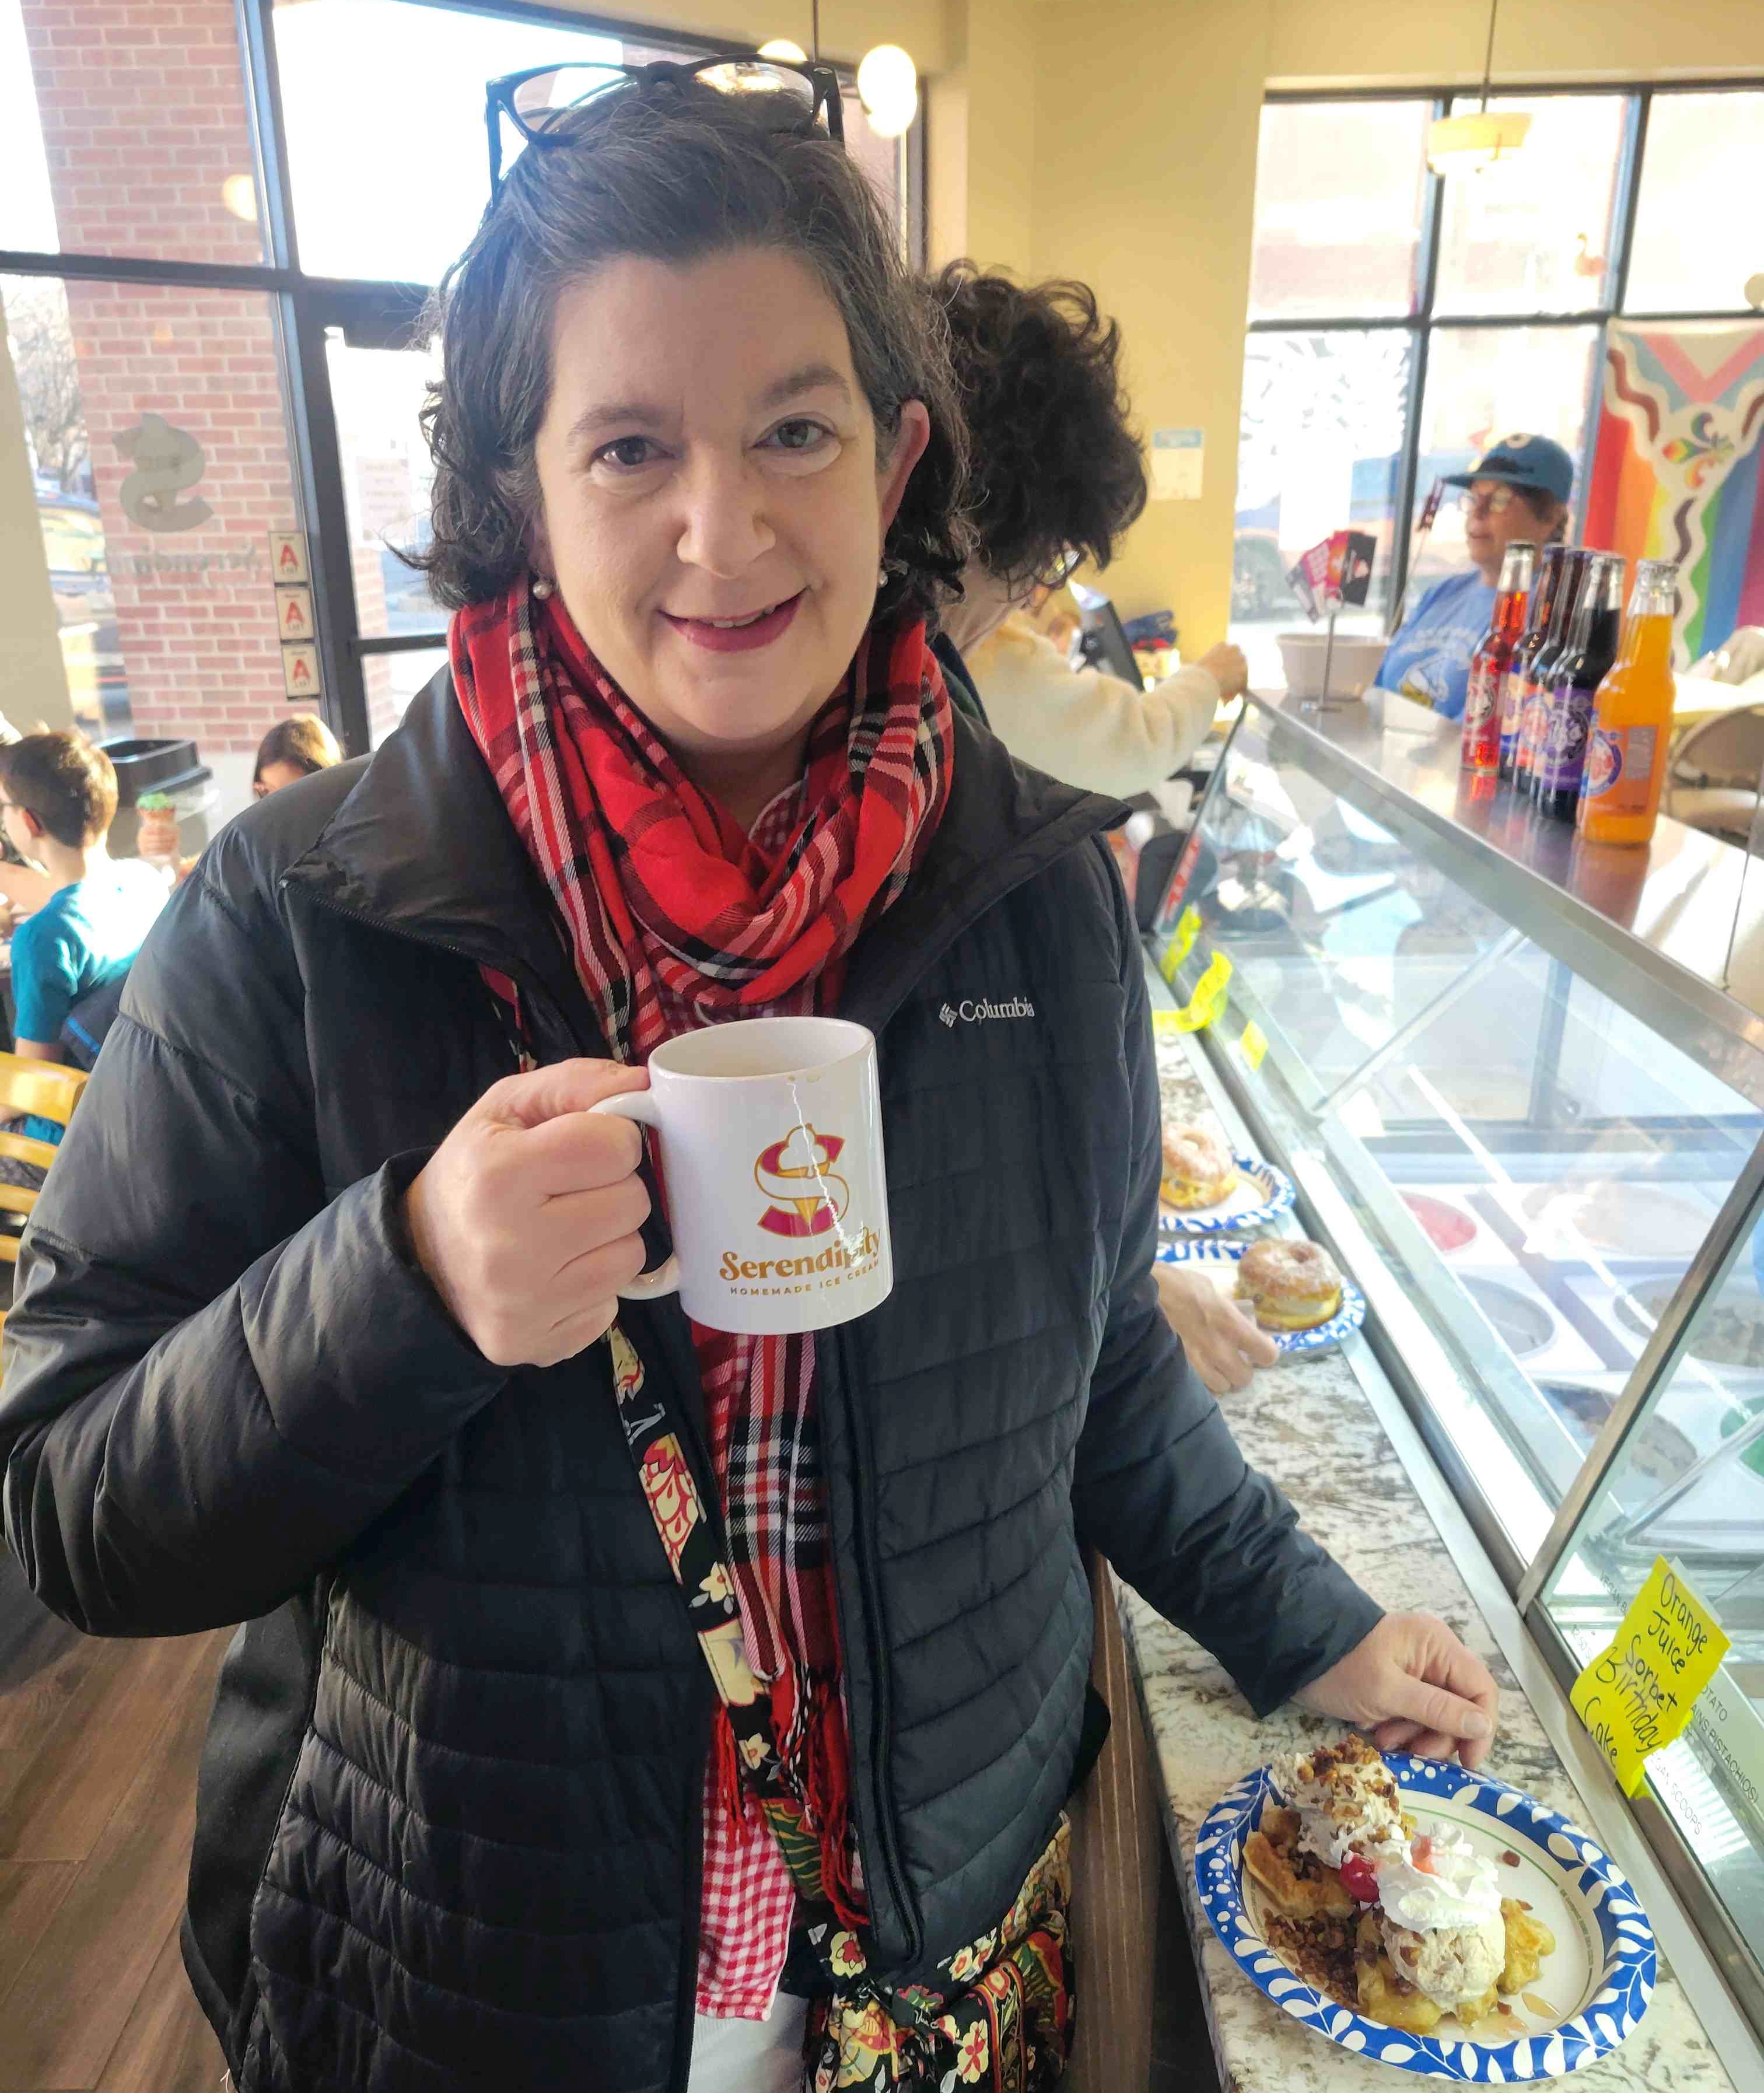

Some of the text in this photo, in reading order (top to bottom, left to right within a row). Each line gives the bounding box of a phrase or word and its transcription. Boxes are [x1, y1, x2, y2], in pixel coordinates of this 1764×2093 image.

[279, 542, 299, 567] A
[285, 600, 305, 625] A
[292, 658, 312, 681] A
[958, 996, 1035, 1022] Columbia
[730, 1283, 812, 1296] HOMEMADE
[819, 1276, 841, 1289] ICE
[1647, 1609, 1686, 1675] Juice
[1660, 1572, 1709, 1658] Orange
[1595, 1646, 1663, 1753] Birthday
[1625, 1634, 1678, 1713] Sorbet
[1584, 1696, 1620, 1768] Cake
[1708, 1728, 1759, 1804] PISTACHIOS)
[1671, 1782, 1703, 1835] SCOOPS
